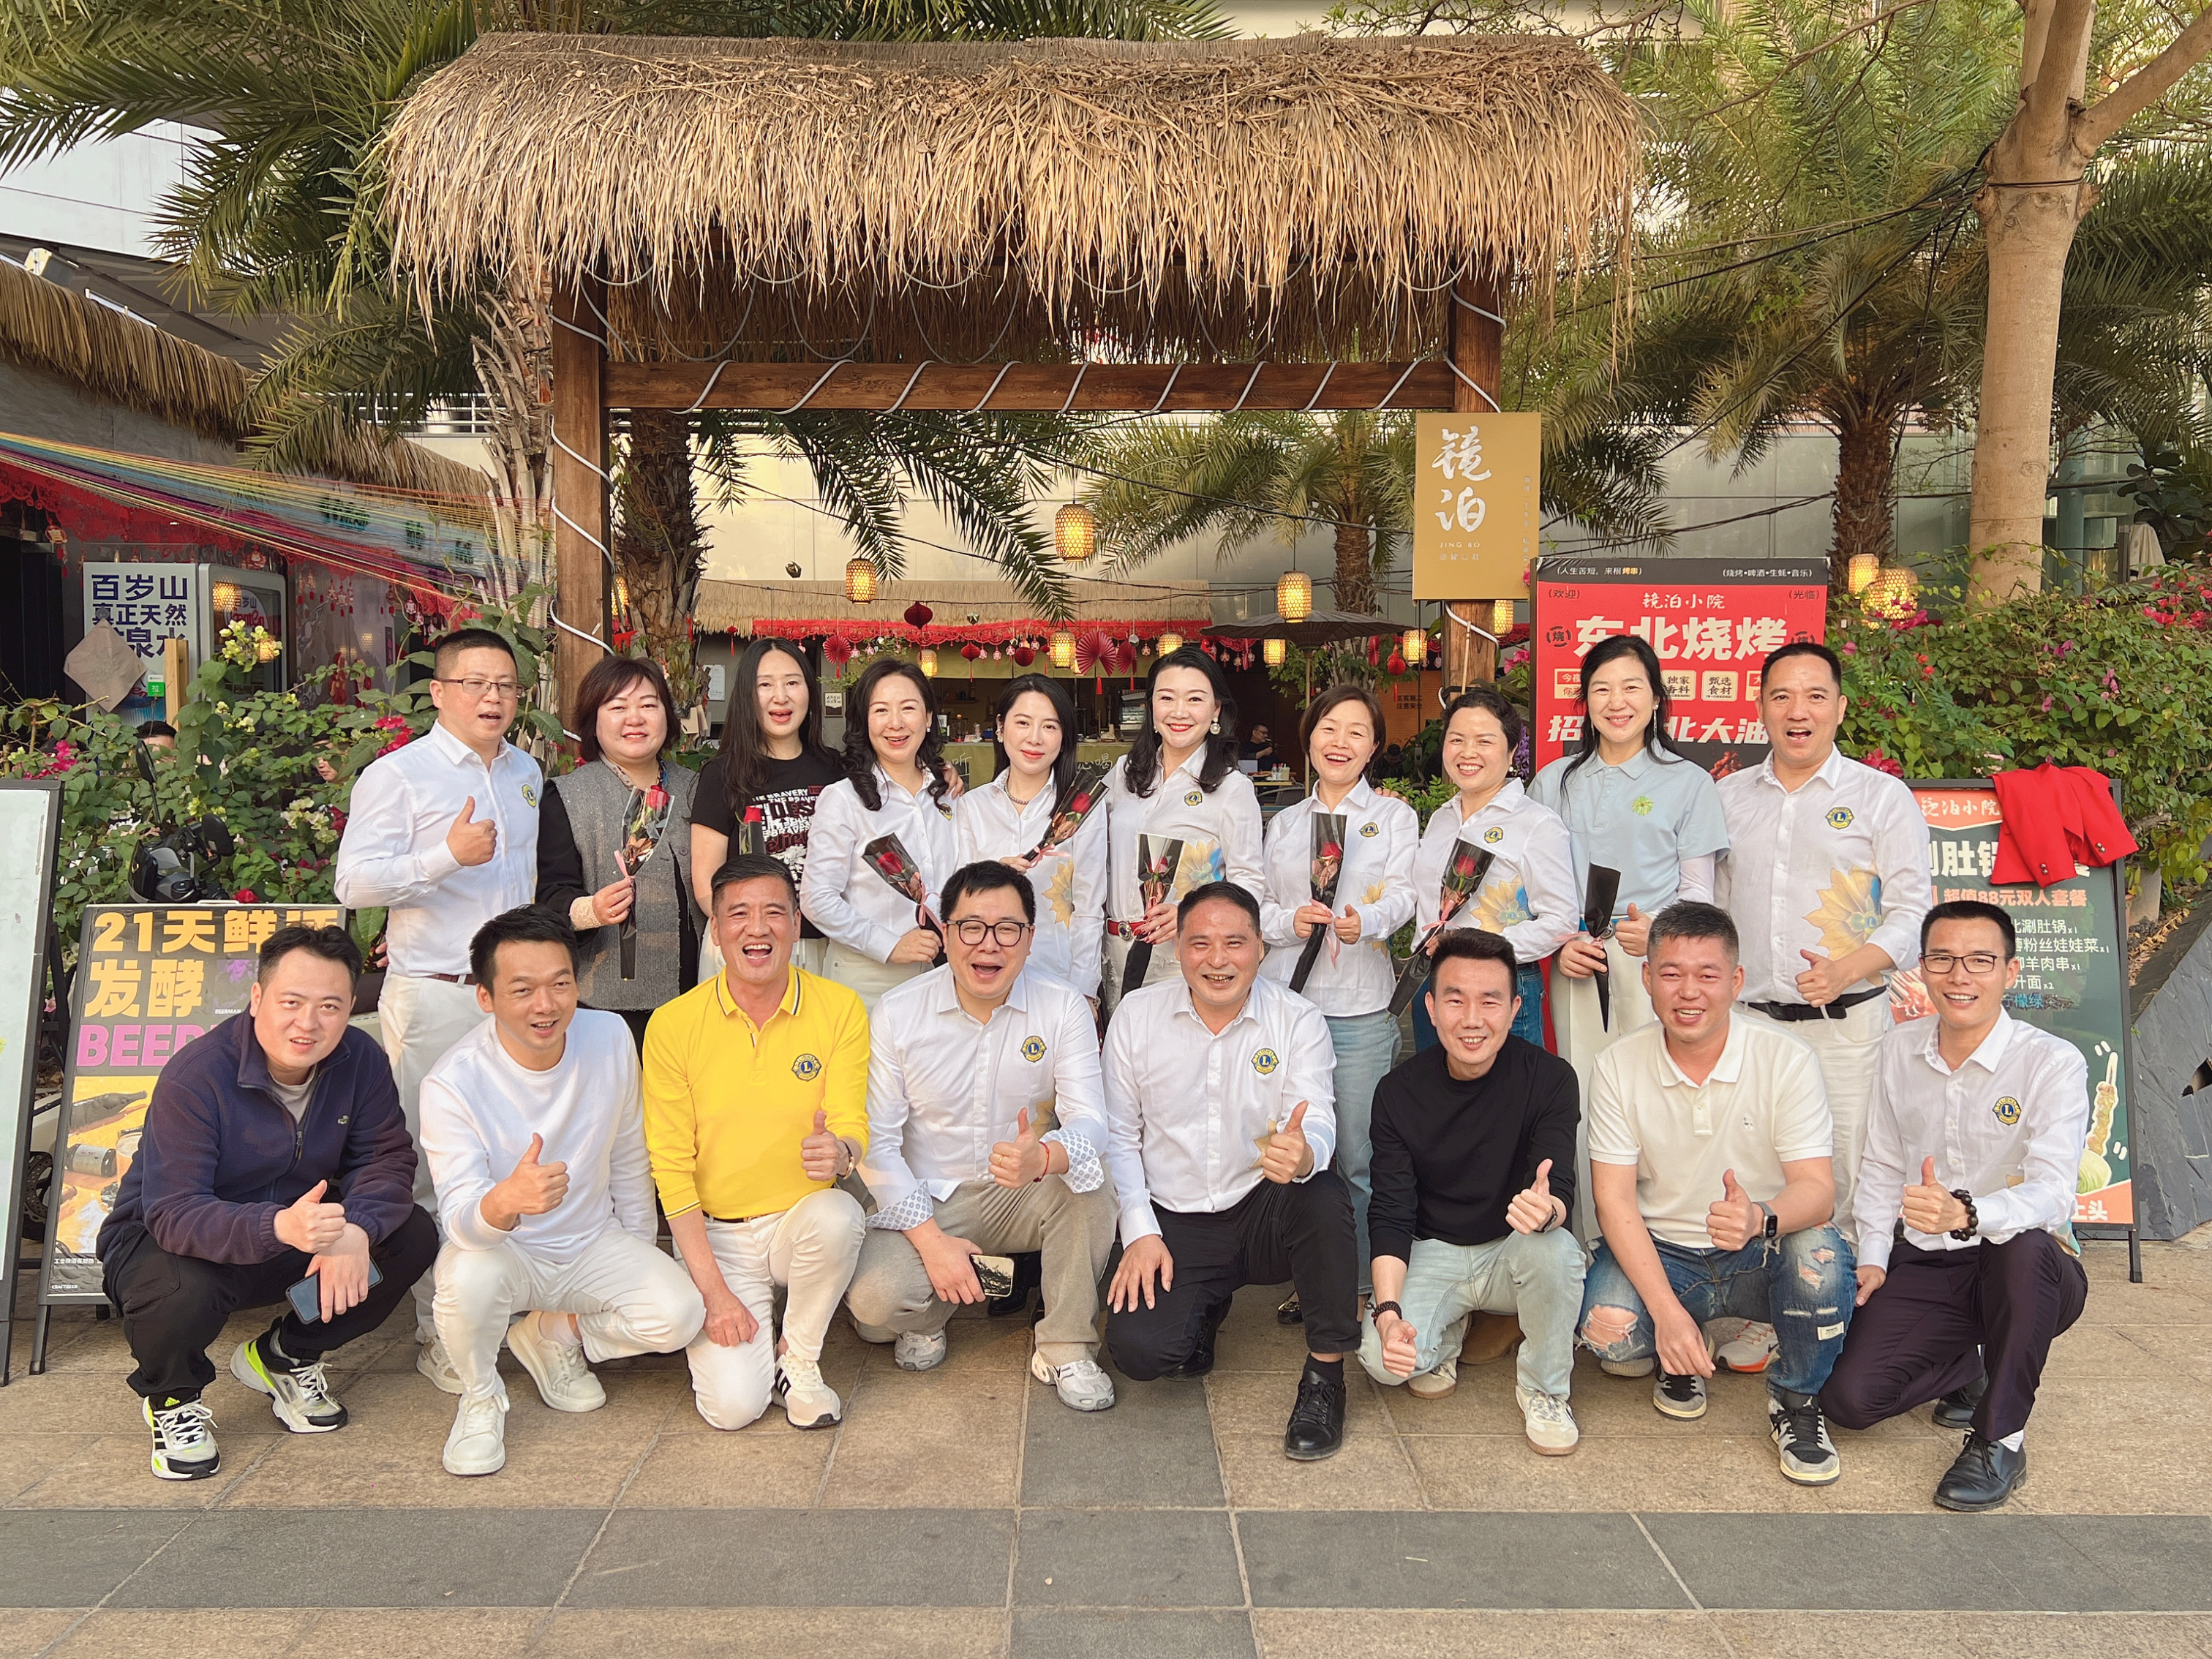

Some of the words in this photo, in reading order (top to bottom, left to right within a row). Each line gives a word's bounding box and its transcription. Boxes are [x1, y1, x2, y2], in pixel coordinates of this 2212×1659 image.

[1432, 426, 1492, 533] 镜泊
[91, 573, 188, 601] 百岁山
[1641, 592, 1726, 609] 镜泊小院
[1573, 615, 1787, 661] 东北烧烤
[1667, 675, 1690, 685] 独家
[1708, 685, 1732, 695] 食材
[767, 789, 808, 800] BRAVERY
[84, 959, 205, 1018] 发酵
